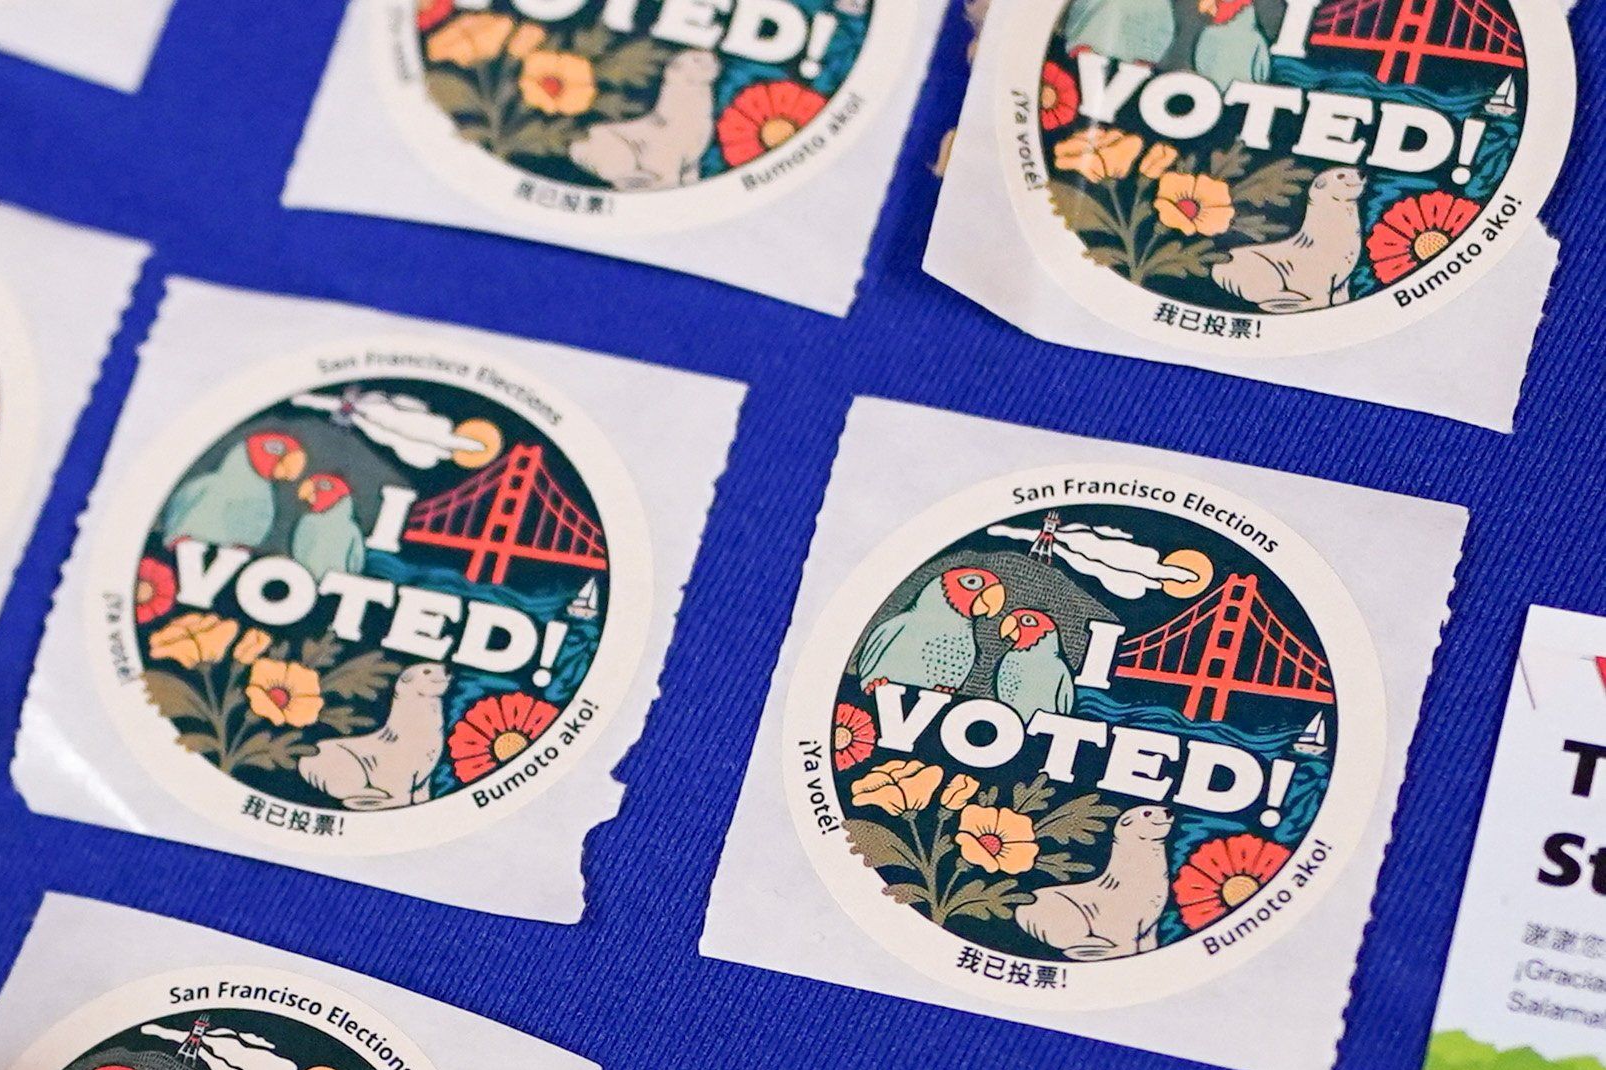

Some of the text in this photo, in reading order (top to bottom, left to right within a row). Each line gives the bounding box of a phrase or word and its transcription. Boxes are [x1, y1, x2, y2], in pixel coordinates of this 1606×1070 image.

[456, 0, 838, 79] ED!
[1270, 0, 1316, 59] I
[1077, 51, 1484, 186] VOTED!
[1392, 193, 1522, 308] Bumoto ako!
[1153, 301, 1262, 340] 我已投票!
[366, 486, 416, 552] I
[1012, 479, 1279, 554] San Francisco Elections
[171, 541, 568, 688] VOTED!
[1073, 619, 1125, 691] I
[471, 698, 600, 810] Bumoto ako!
[799, 741, 840, 835] ¡Ya voté!
[873, 684, 1296, 828] VOTED!
[240, 794, 345, 837] 我已投票!
[1202, 838, 1334, 956] Bumoto ako!
[169, 986, 210, 1004] San
[217, 981, 322, 1016] Francisco
[955, 945, 1067, 989] 我已投票!
